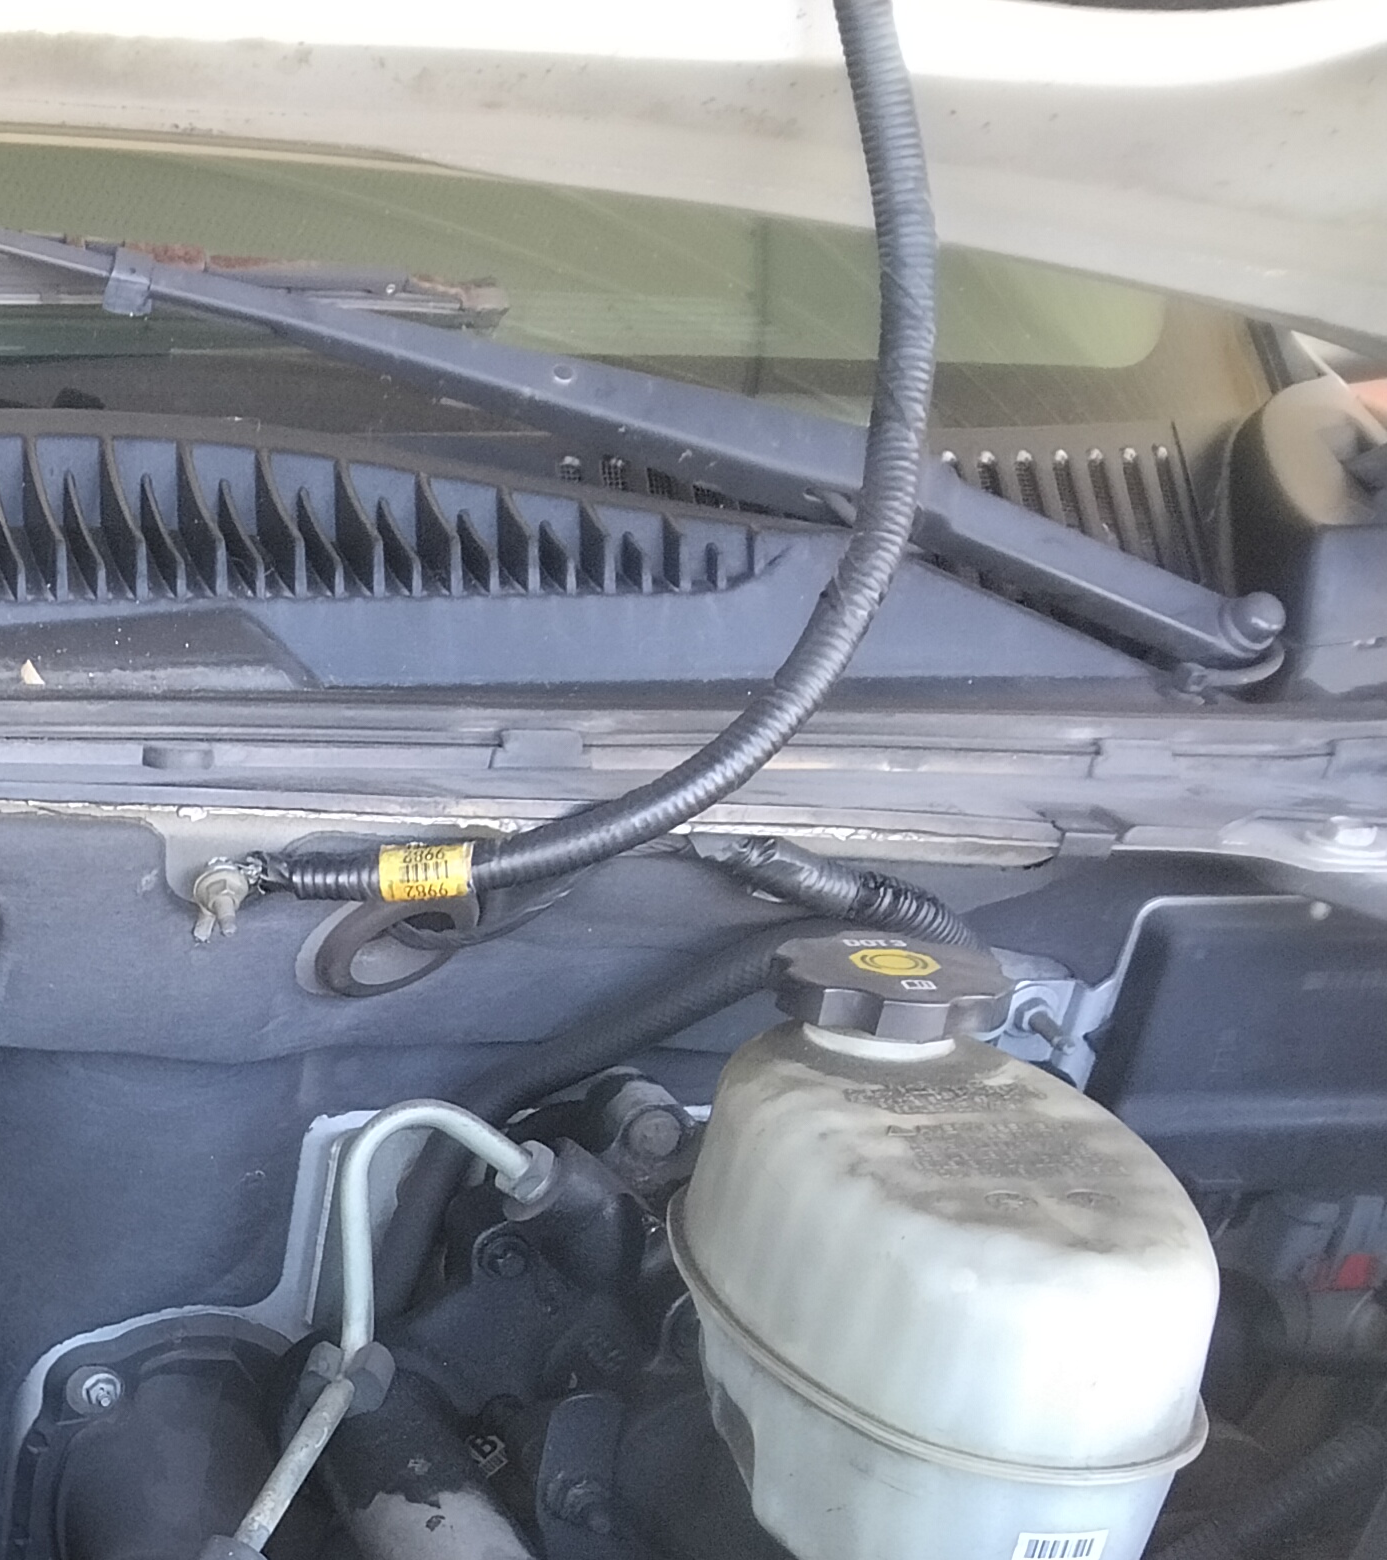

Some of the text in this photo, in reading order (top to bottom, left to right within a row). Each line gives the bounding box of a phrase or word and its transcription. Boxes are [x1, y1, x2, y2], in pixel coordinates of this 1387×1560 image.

[404, 881, 449, 899] 9982
[842, 938, 907, 948] DOT 3
